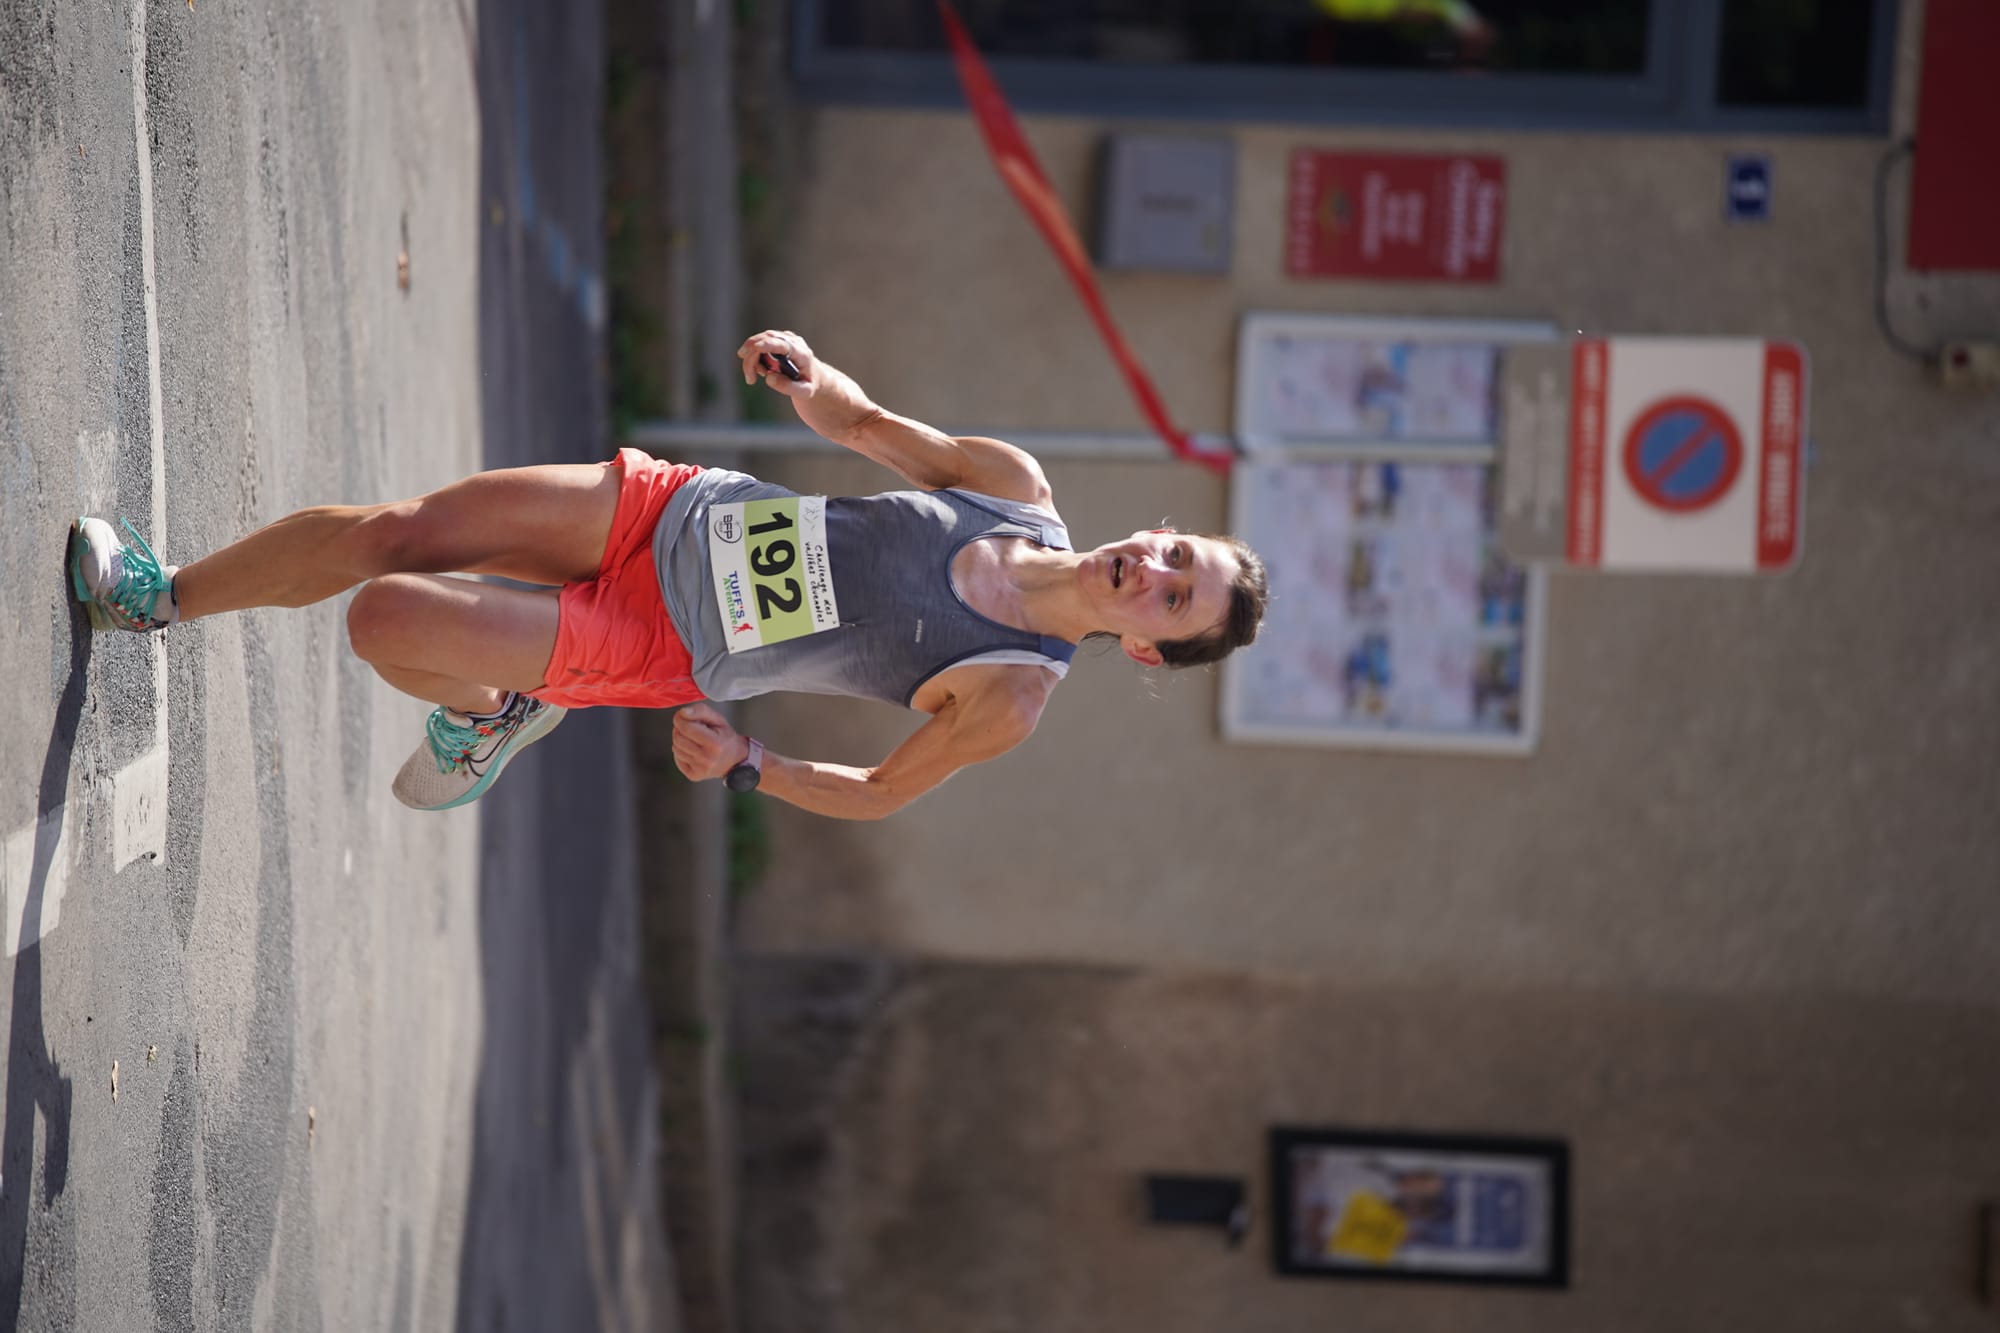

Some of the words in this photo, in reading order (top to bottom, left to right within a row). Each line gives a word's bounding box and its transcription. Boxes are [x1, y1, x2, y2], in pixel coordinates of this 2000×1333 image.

[748, 512, 802, 620] 192
[804, 541, 816, 575] vallées
[814, 544, 827, 593] Challenge
[823, 599, 833, 616] des
[722, 577, 739, 625] Aventure
[728, 570, 745, 619] TUFF'S
[809, 580, 824, 623] cévenoles
